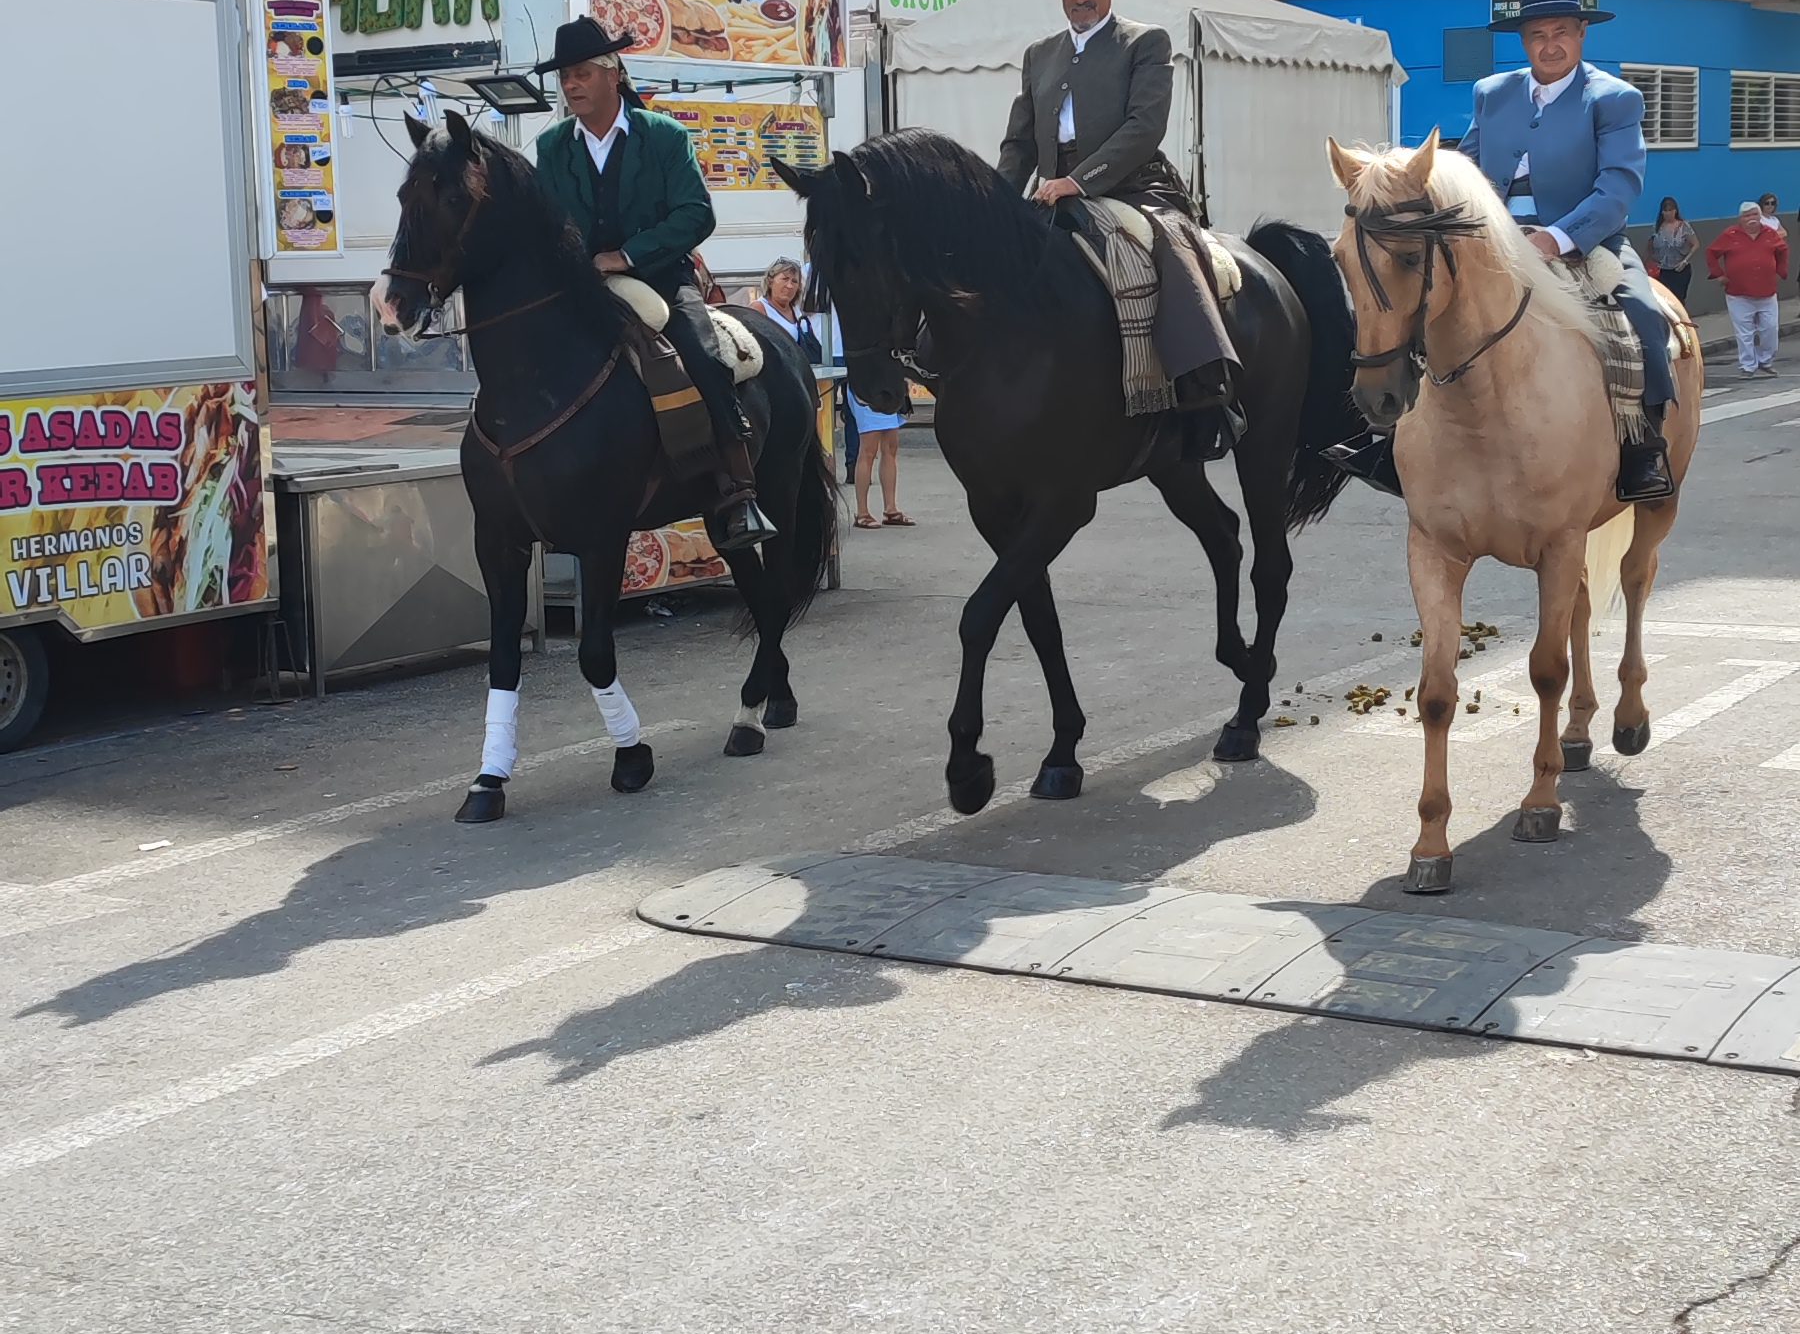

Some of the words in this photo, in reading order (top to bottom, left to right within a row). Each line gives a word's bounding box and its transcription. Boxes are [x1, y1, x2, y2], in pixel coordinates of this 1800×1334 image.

[19, 410, 183, 453] ASADAS
[37, 461, 180, 505] KEBAB
[11, 521, 144, 562] HERMANOS
[6, 552, 152, 609] VILLAR
